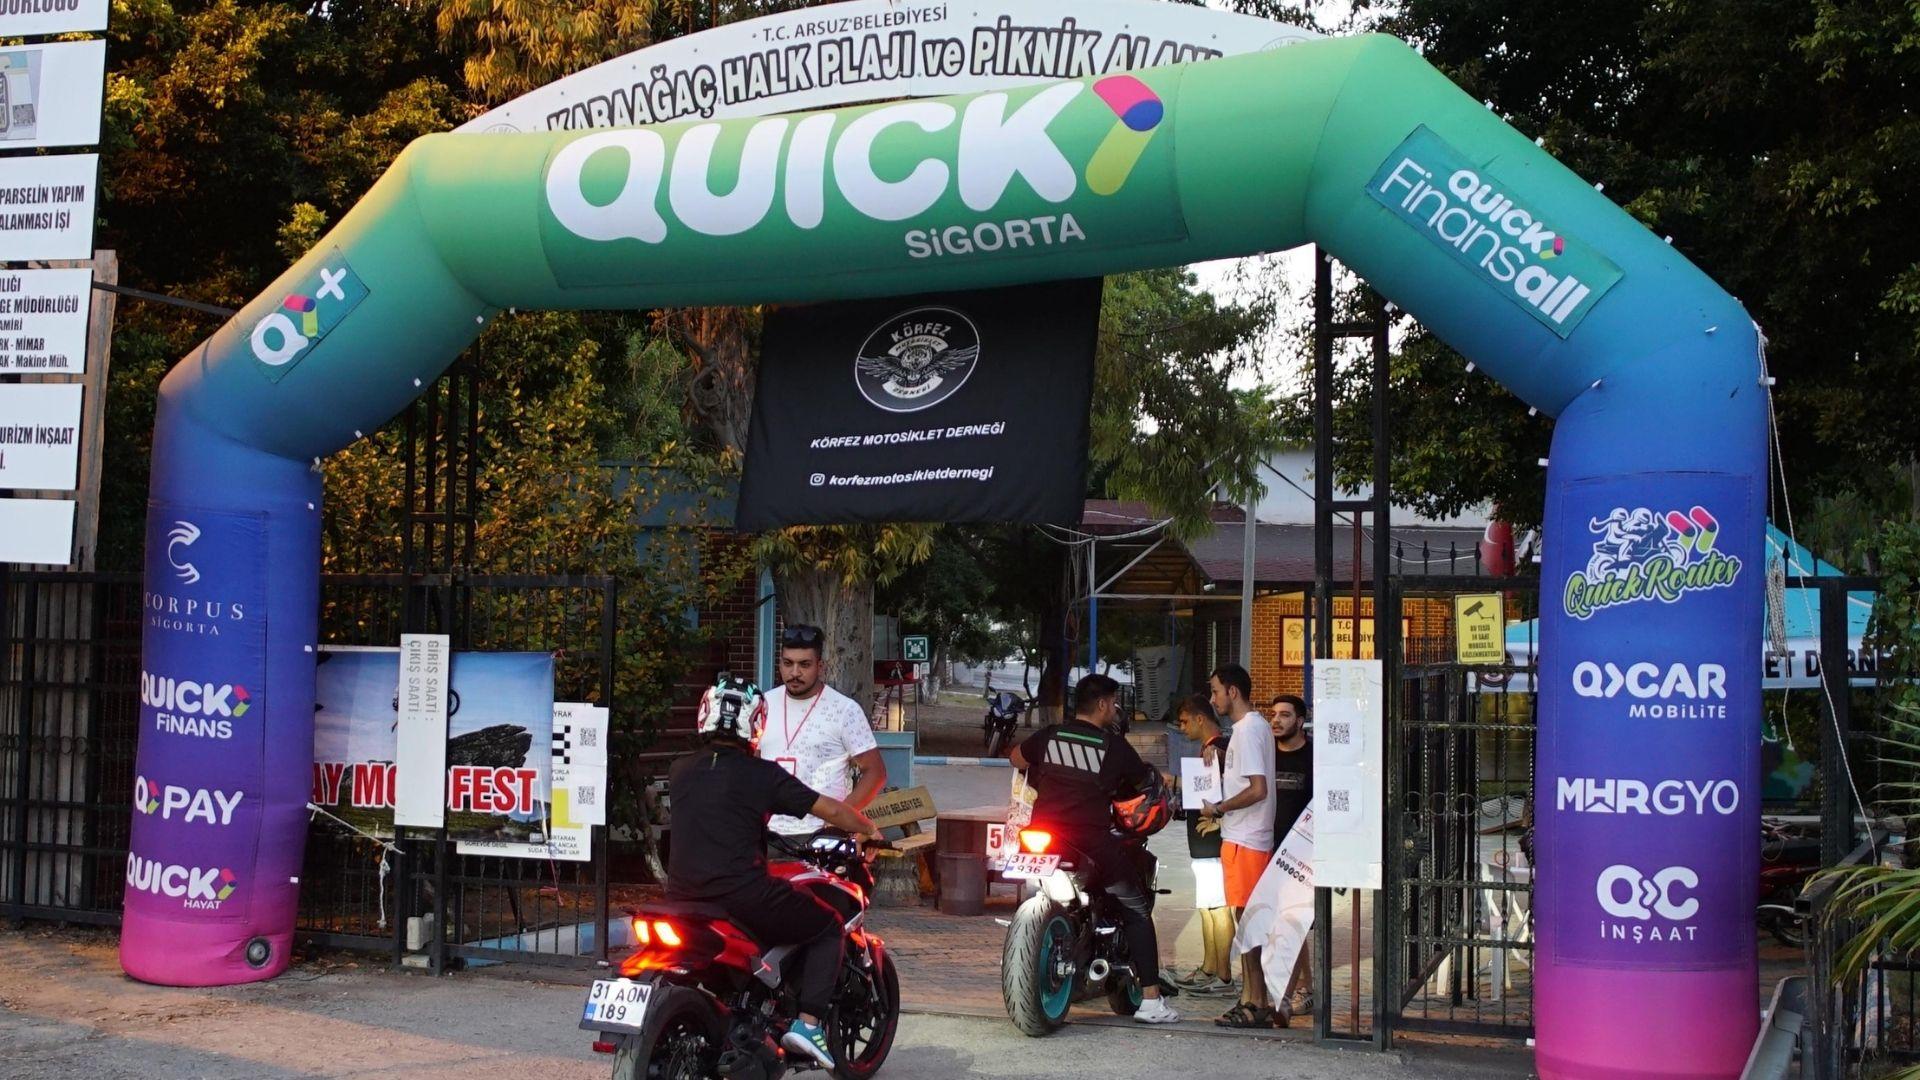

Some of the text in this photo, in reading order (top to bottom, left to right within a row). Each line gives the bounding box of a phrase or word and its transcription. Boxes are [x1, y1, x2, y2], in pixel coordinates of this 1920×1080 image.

[763, 3, 948, 42] T.C. ARSUZ BELEDİYESİ
[721, 42, 812, 105] HALK
[817, 29, 917, 87] PLAJI
[921, 33, 965, 77] ve
[969, 14, 1101, 79] PİKNİK
[546, 81, 1084, 244] QUICK
[0, 184, 85, 205] PARSELİN YAPIM
[0, 209, 70, 232] ALANMASI İŞİ
[1448, 169, 1556, 254] QUICK
[0, 275, 21, 293] LIĞI
[14, 294, 79, 313] MÜDÜRLÜĞÜ
[15, 336, 45, 351] MİMAR
[891, 322, 951, 343] KÖRFEZ
[15, 354, 48, 368] Makine
[48, 354, 69, 368] Müh.
[0, 422, 75, 448] URİZM İNŞAAT
[810, 421, 1006, 449] KÖRFEZ MOTOSİKLET DERNEĞİ
[829, 466, 994, 486] korfezmotosikletdernegi
[1564, 549, 1742, 620] Quick Routes
[145, 591, 244, 621] CORPUS
[406, 640, 421, 672] ÇIKIŞ
[424, 640, 441, 673] GİRİŞ
[141, 670, 233, 717] QUICK
[408, 677, 421, 712] SAATİ
[425, 678, 440, 712] SAATİ
[162, 784, 244, 825] PAY
[1012, 854, 1026, 863] 31
[126, 851, 220, 900] QUICK
[183, 898, 222, 910] HAYAT
[1600, 920, 1698, 944] İNŞAAT
[593, 982, 649, 1003] 31 AON
[600, 1003, 627, 1020] 189
